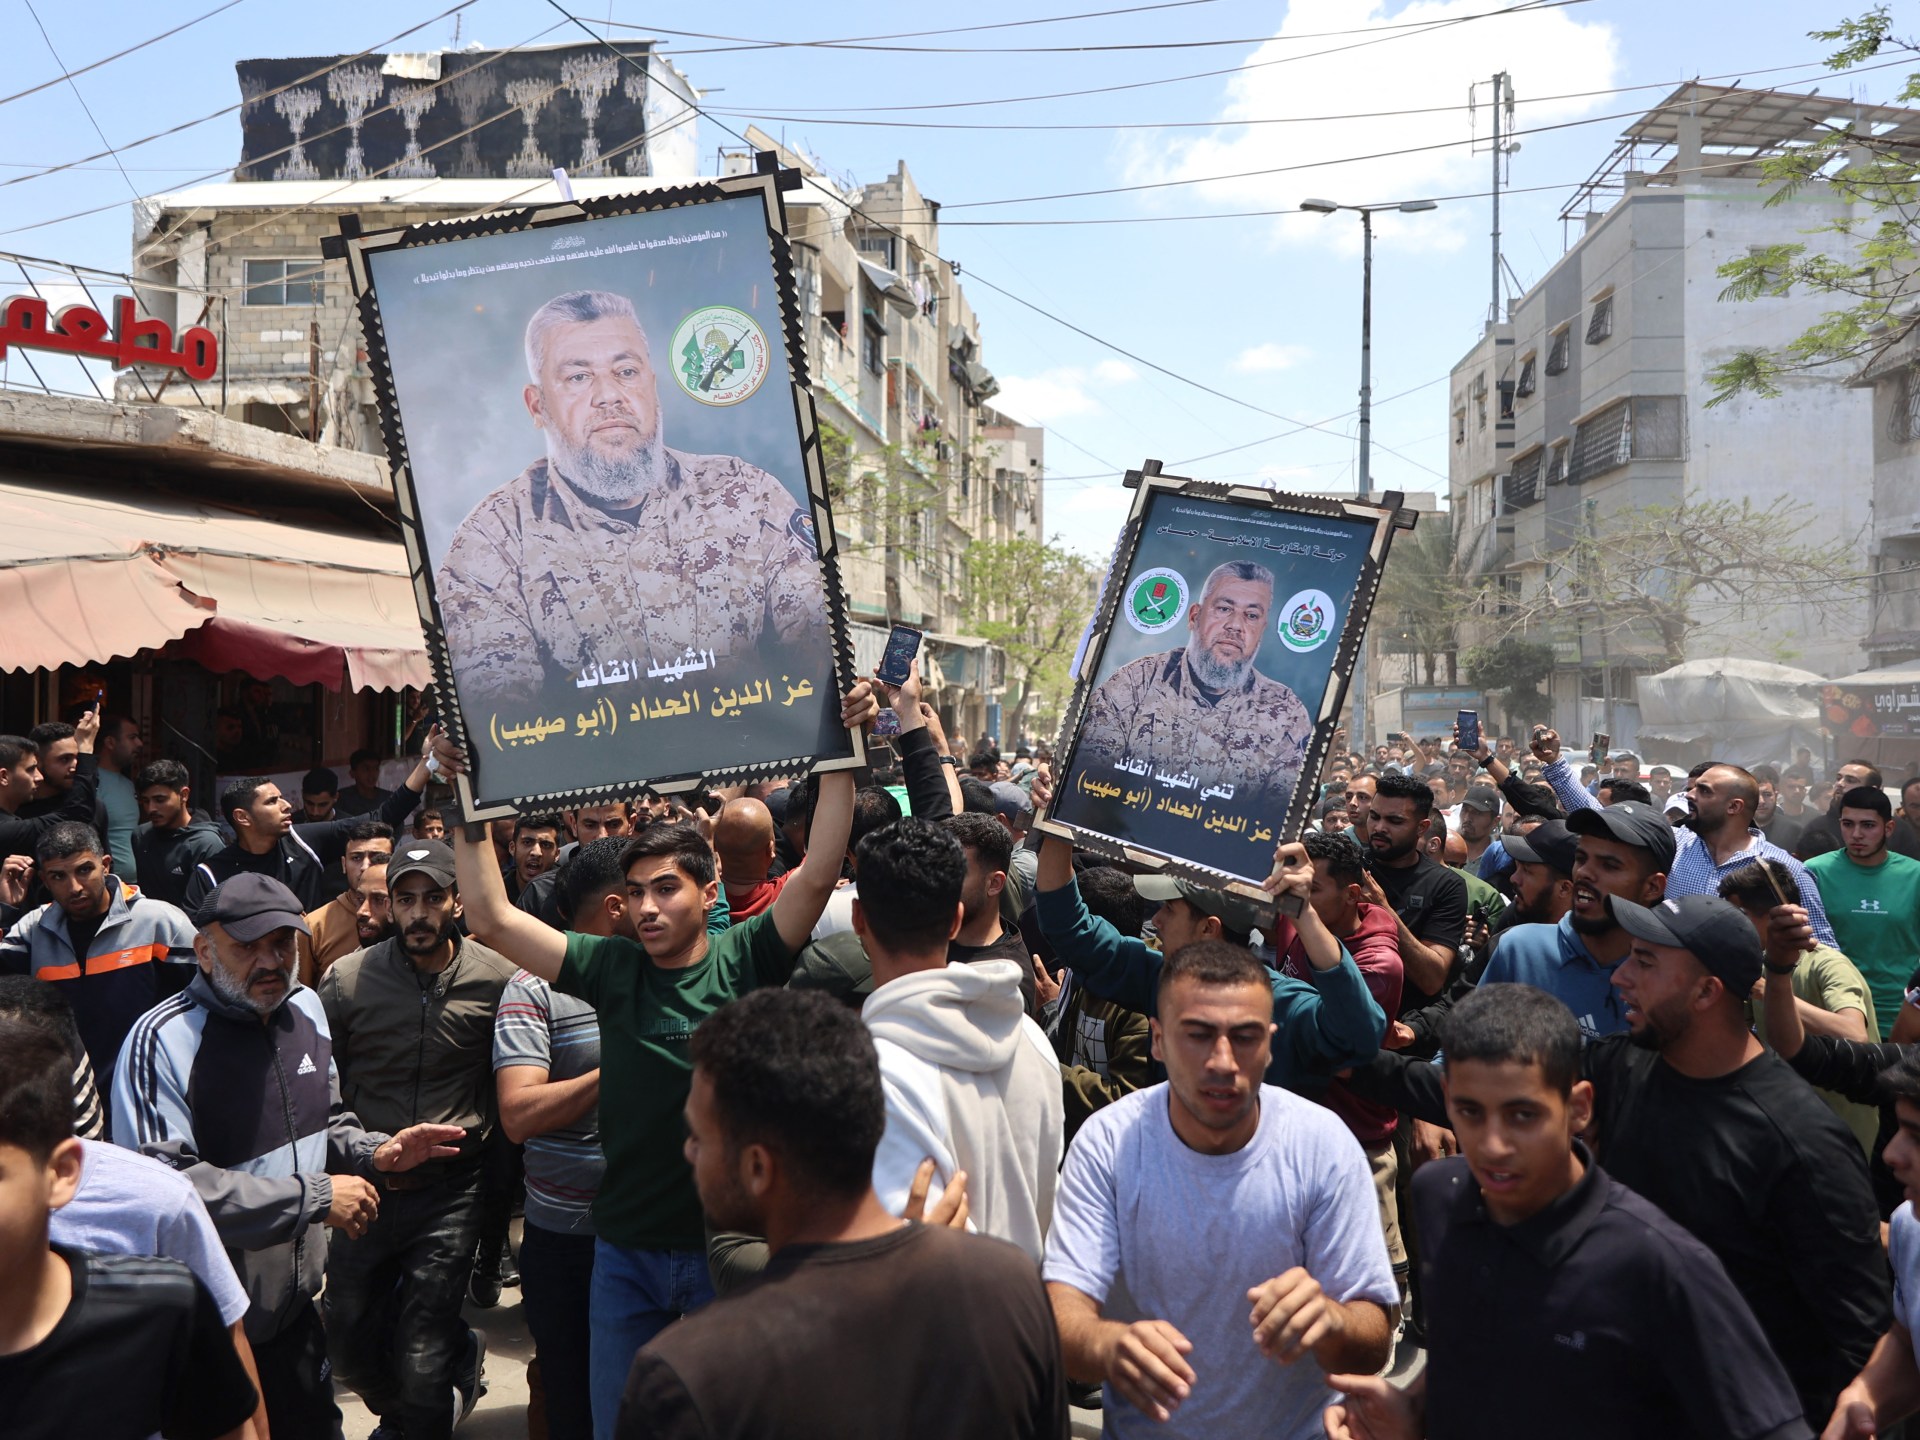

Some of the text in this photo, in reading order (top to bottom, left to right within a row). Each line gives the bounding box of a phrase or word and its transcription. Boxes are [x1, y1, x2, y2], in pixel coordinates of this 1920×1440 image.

[0, 297, 218, 381] مطعم
[1156, 523, 1200, 538] حماس
[1264, 537, 1310, 556] المقاومة
[1312, 546, 1346, 562] حركة
[576, 647, 716, 688] الشهيد القائد
[490, 674, 814, 751] عز الدين الحداد (أبو صهيب)
[1113, 757, 1234, 801] تنعي الشهيد القائد
[1077, 769, 1272, 842] عز الدين الحداد (أبو صهيب)
[297, 1065, 316, 1075] adidas
